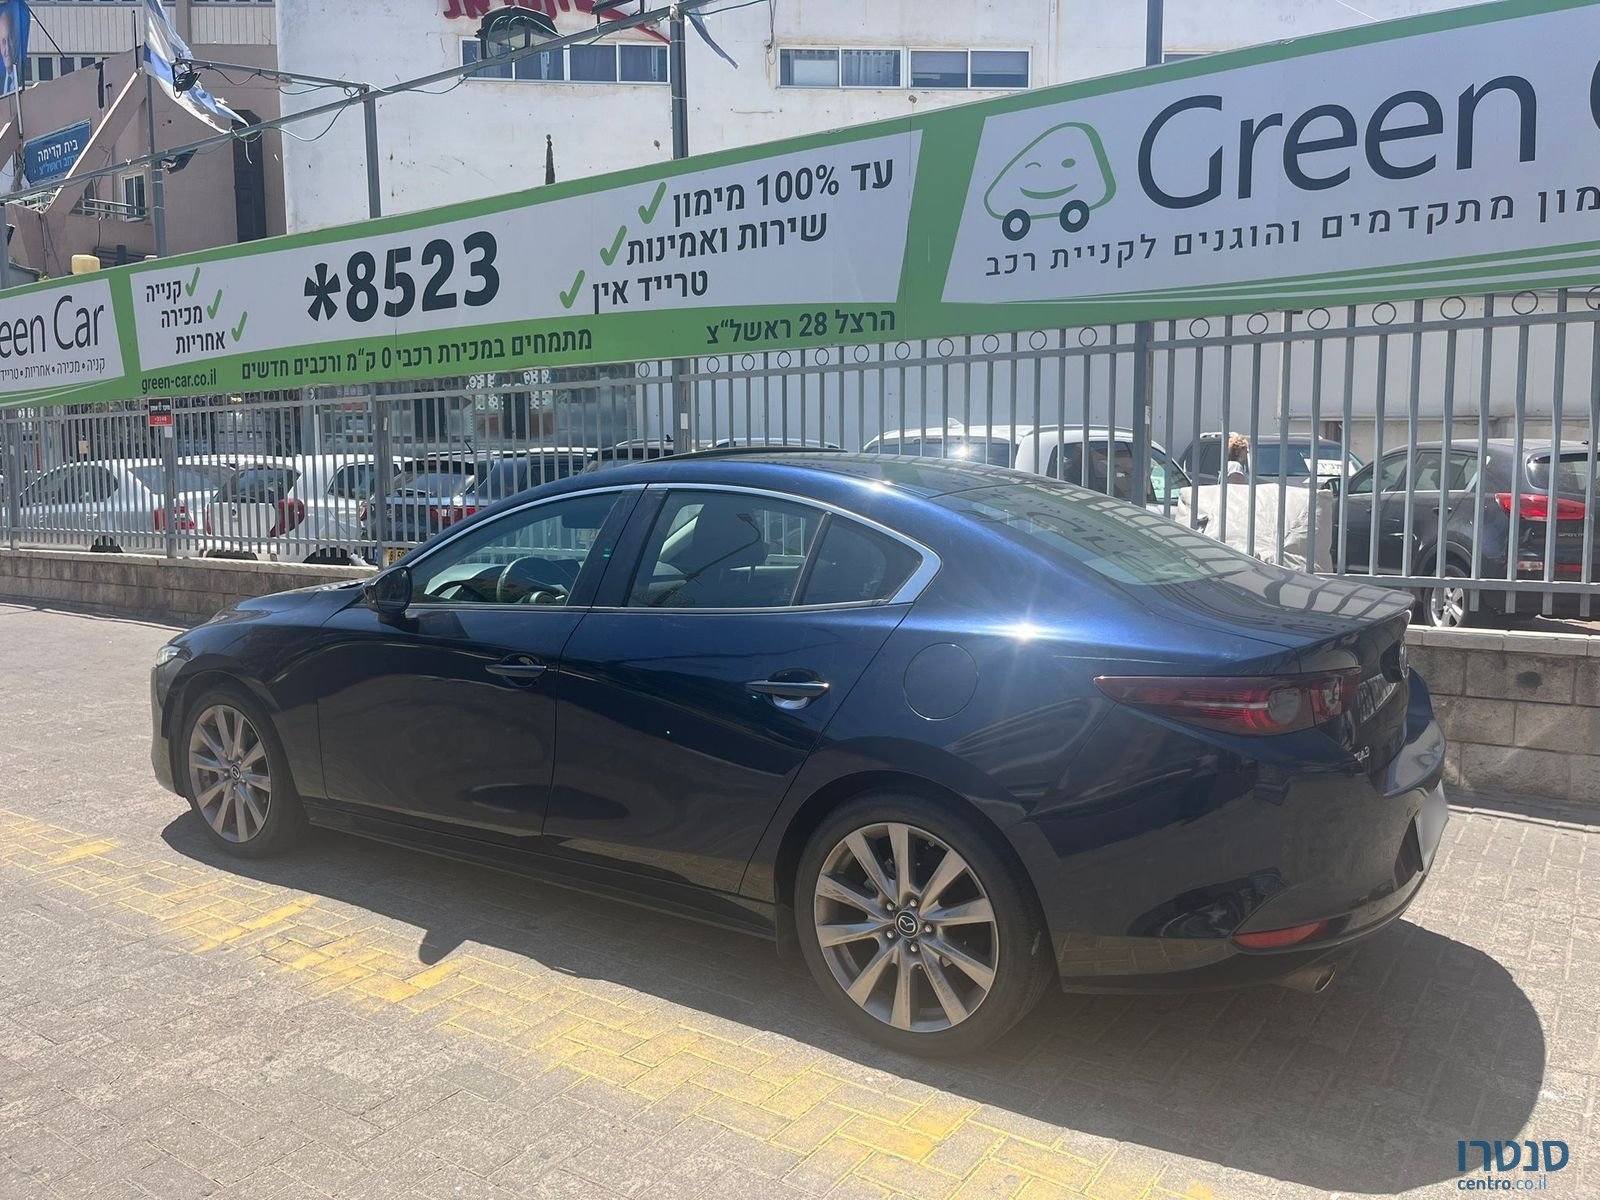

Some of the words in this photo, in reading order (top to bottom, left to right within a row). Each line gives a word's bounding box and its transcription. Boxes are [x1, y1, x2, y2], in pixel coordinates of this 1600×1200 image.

[37, 143, 62, 162] קדימה
[64, 139, 79, 154] בית
[1138, 75, 1537, 209] Green
[756, 164, 840, 206] 100%
[850, 158, 894, 192] עד
[673, 183, 745, 227] מימון
[1321, 194, 1514, 239] מתקדמים
[737, 212, 828, 252] שירות
[1174, 220, 1299, 256] והוגנים
[626, 226, 728, 266] ואמינות
[1050, 233, 1157, 269] לקניית
[985, 252, 1036, 276] רכב
[146, 280, 182, 304] קנייה
[592, 280, 629, 315] אין
[637, 269, 708, 302] טרייד
[53, 294, 104, 350] Car
[161, 305, 203, 328] מכירה
[799, 313, 828, 338] 28
[834, 308, 896, 333] הרצל
[175, 330, 226, 354] אחריות
[438, 339, 505, 364] במכירת
[511, 328, 592, 356] מתמחים
[57, 360, 80, 375] מכירה
[87, 357, 105, 374] קניה
[241, 358, 289, 380] חדשים
[294, 355, 342, 376] ורכבים
[382, 346, 391, 368] 0
[397, 346, 433, 368] רכבי
[25, 364, 51, 379] אחריות
[141, 368, 217, 394] green-car.co.il
